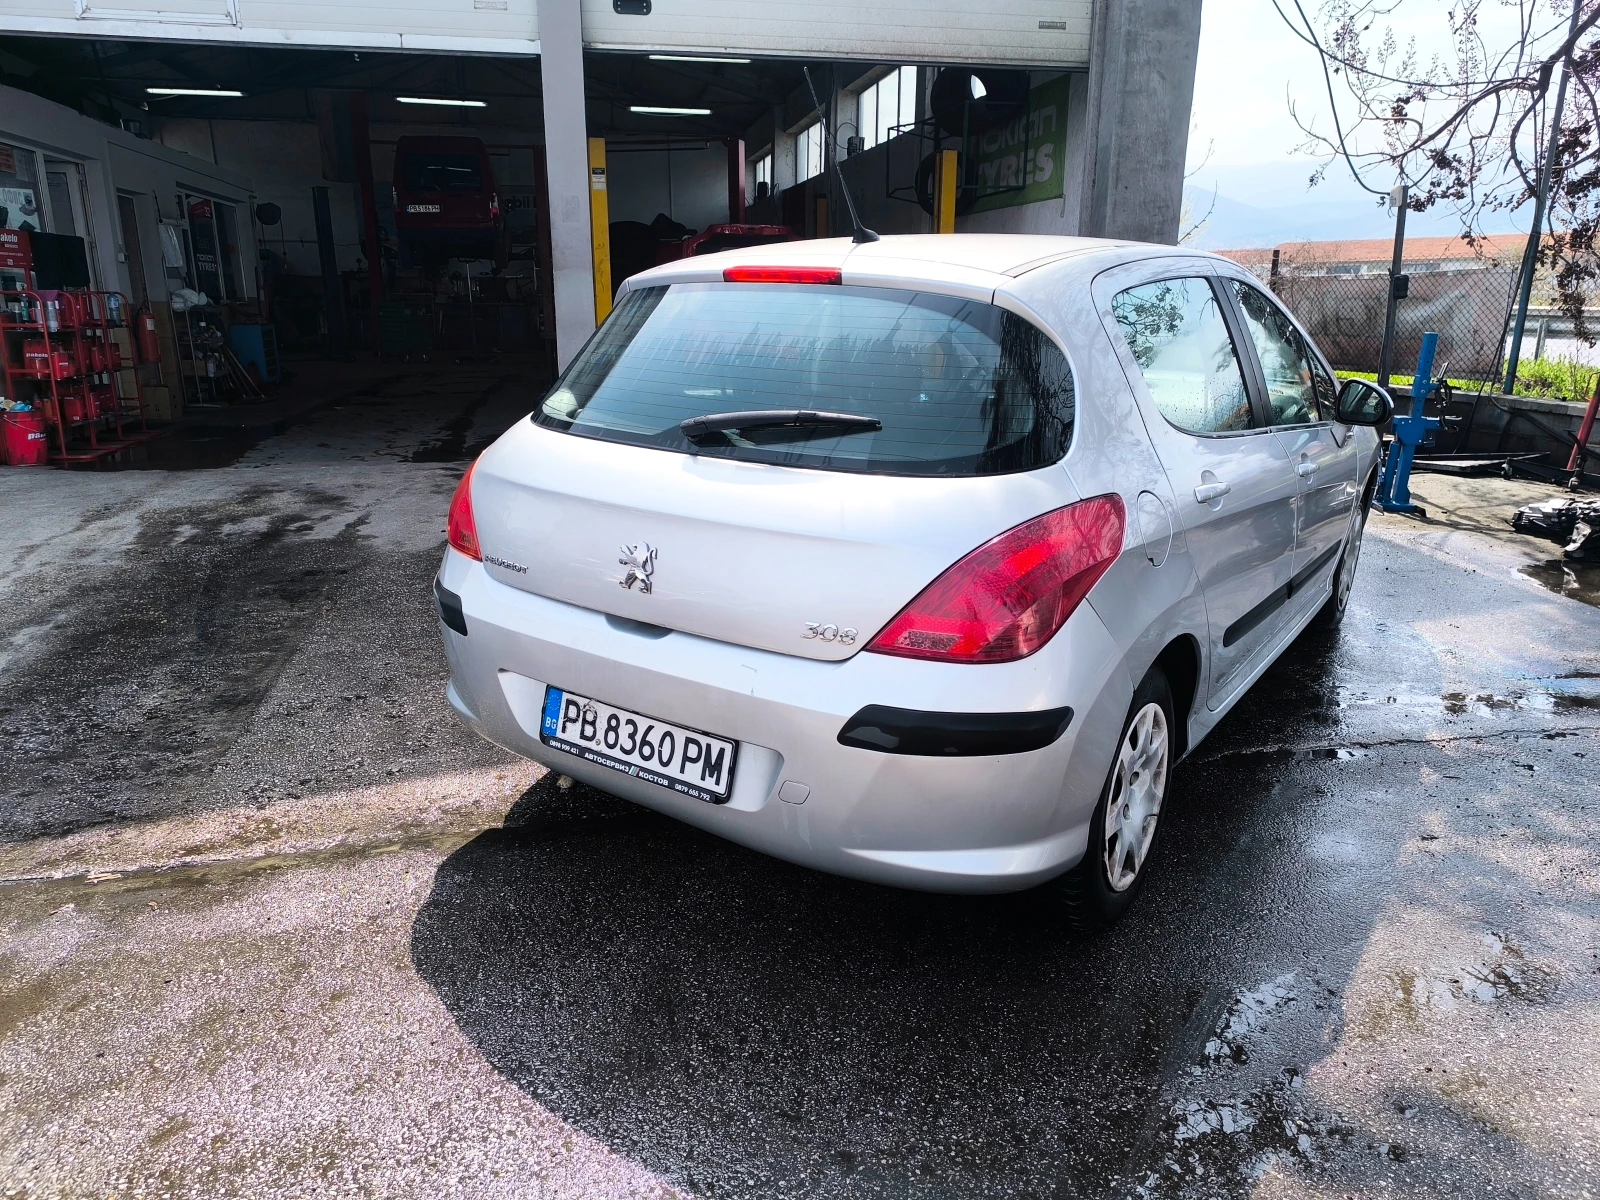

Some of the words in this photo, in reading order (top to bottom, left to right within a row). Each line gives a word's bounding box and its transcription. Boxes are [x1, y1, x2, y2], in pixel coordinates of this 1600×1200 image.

[978, 142, 1054, 193] YRES
[485, 554, 529, 575] PEUGEOT
[799, 621, 858, 646] 308
[545, 716, 557, 730] BG
[584, 752, 630, 773] АВТОСЕРВИЗ
[638, 770, 669, 786] КОСТОВ
